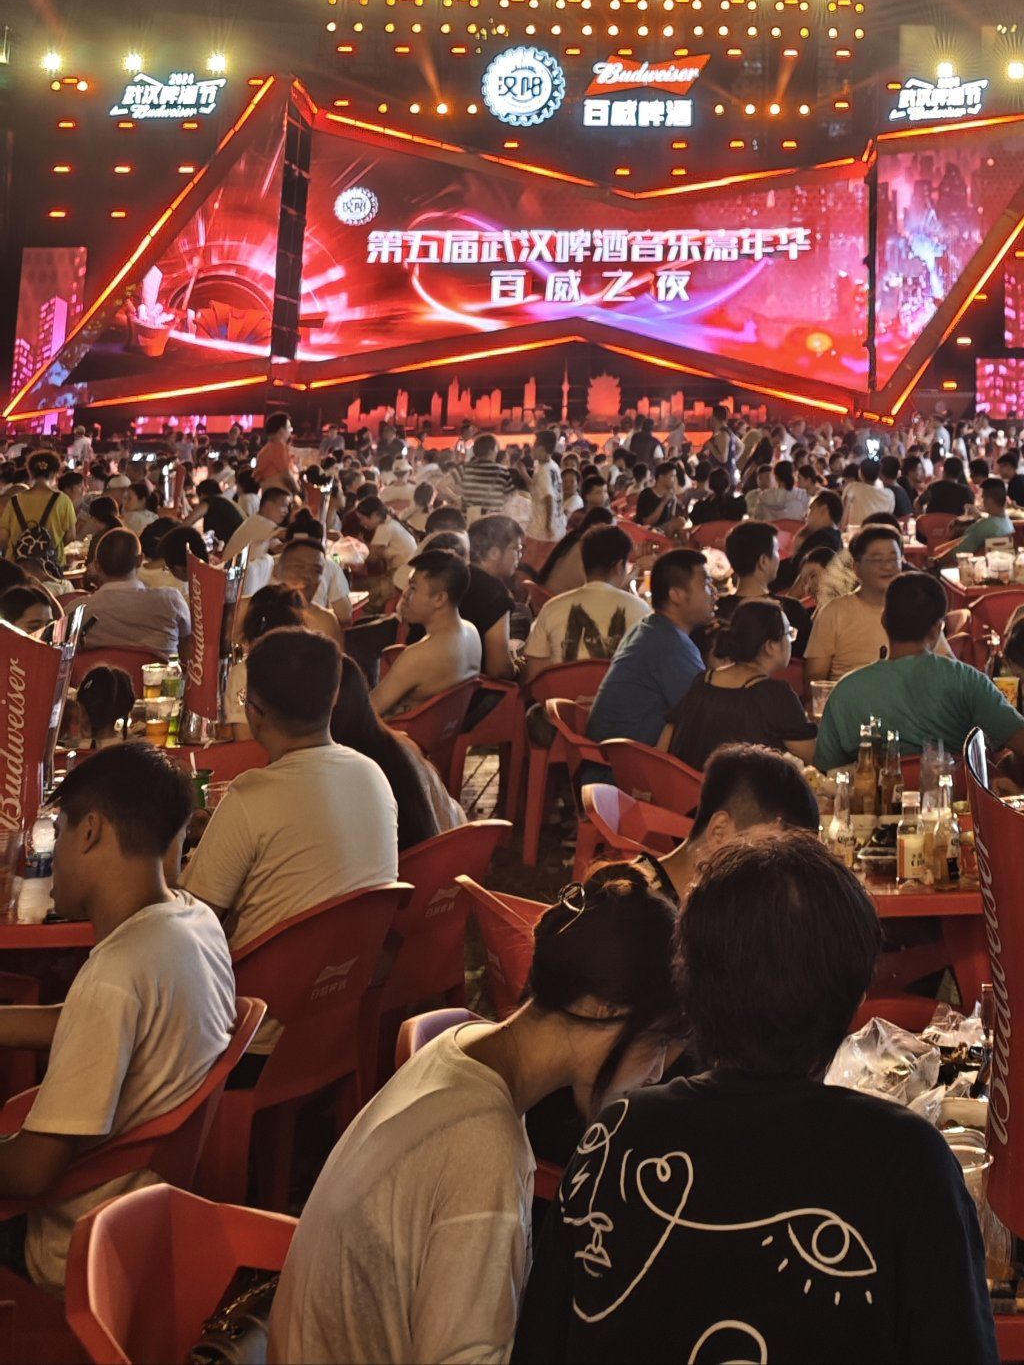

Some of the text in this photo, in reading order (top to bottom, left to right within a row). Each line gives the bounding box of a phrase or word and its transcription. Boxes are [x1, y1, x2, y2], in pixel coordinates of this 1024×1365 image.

[592, 61, 700, 84] Budweiser
[583, 99, 692, 127] 百威啤酒
[366, 227, 812, 264] 第五届武汉啤酒音乐嘉年华
[489, 268, 692, 303] 百威之夜
[185, 572, 206, 692] Budweiser
